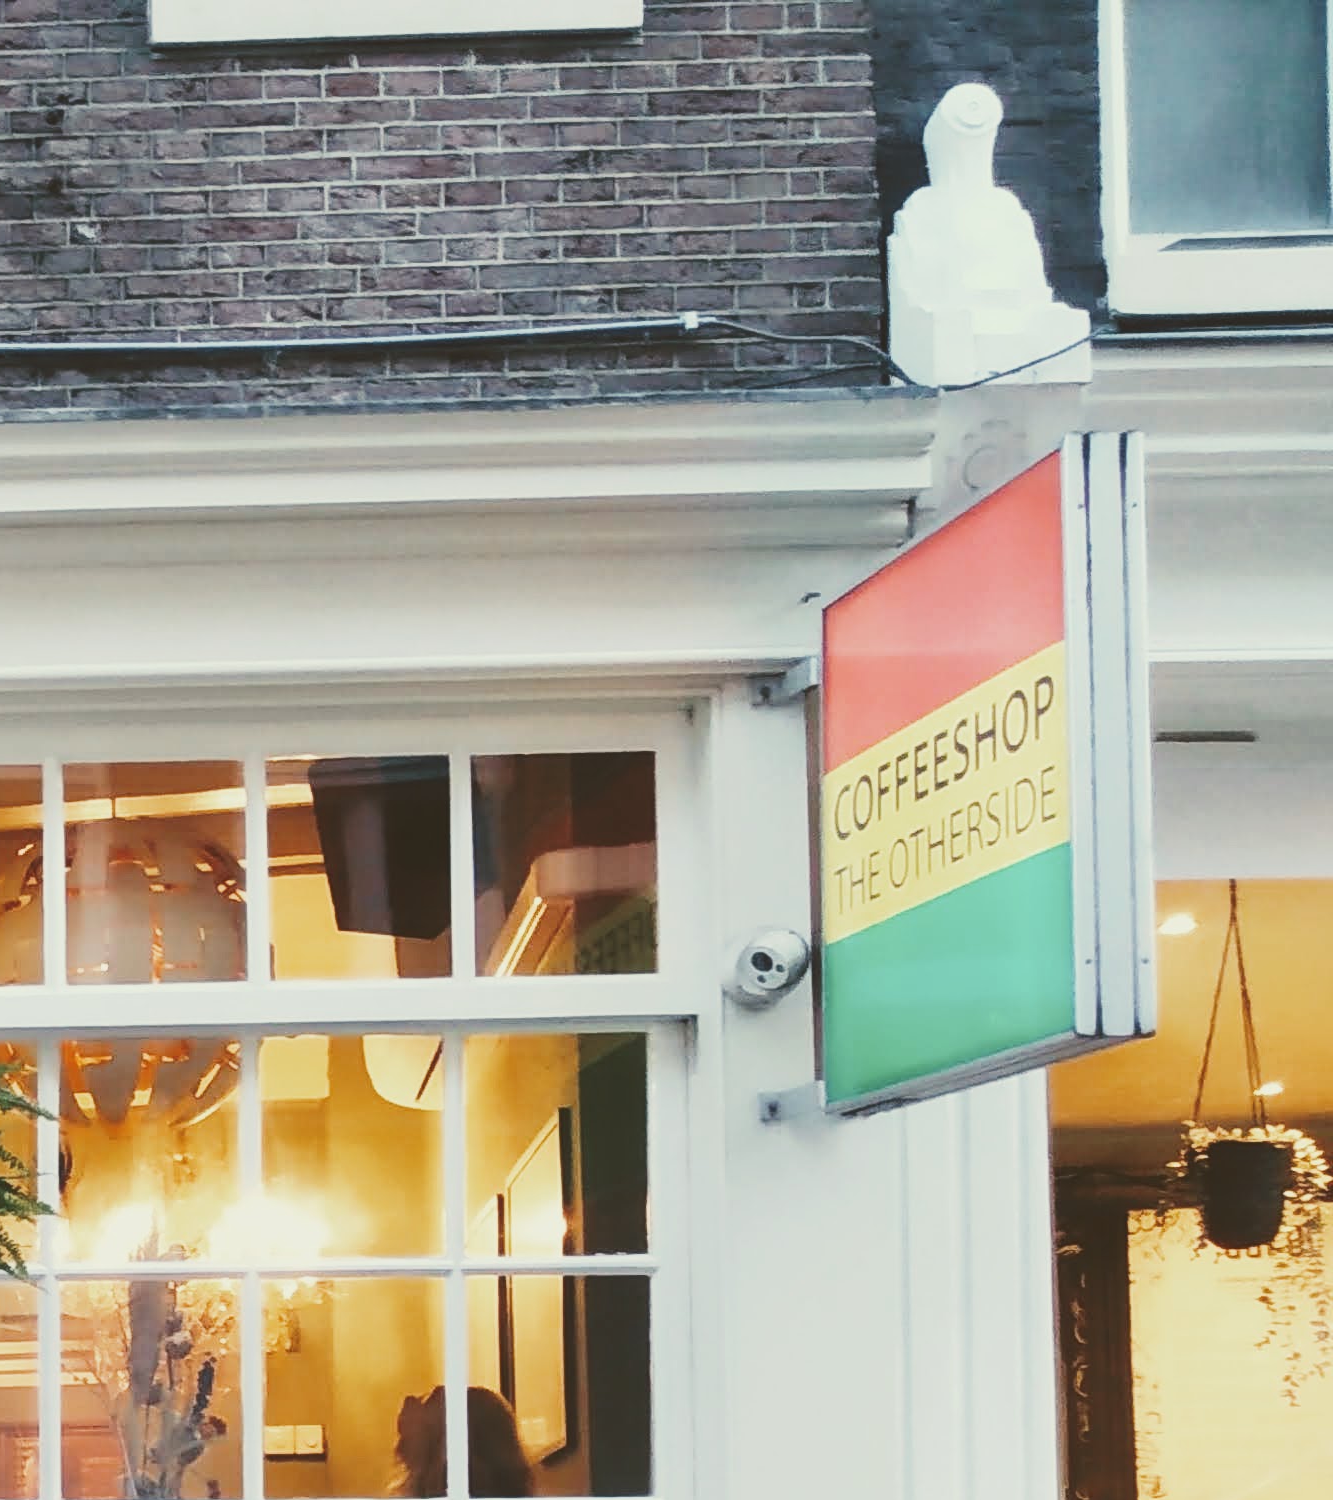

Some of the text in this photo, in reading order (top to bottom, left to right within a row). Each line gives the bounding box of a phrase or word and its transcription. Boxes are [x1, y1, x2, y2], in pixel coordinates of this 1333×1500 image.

[833, 675, 1055, 841] COFFEESHOP
[833, 765, 1057, 915] THE OTHERSIDE
